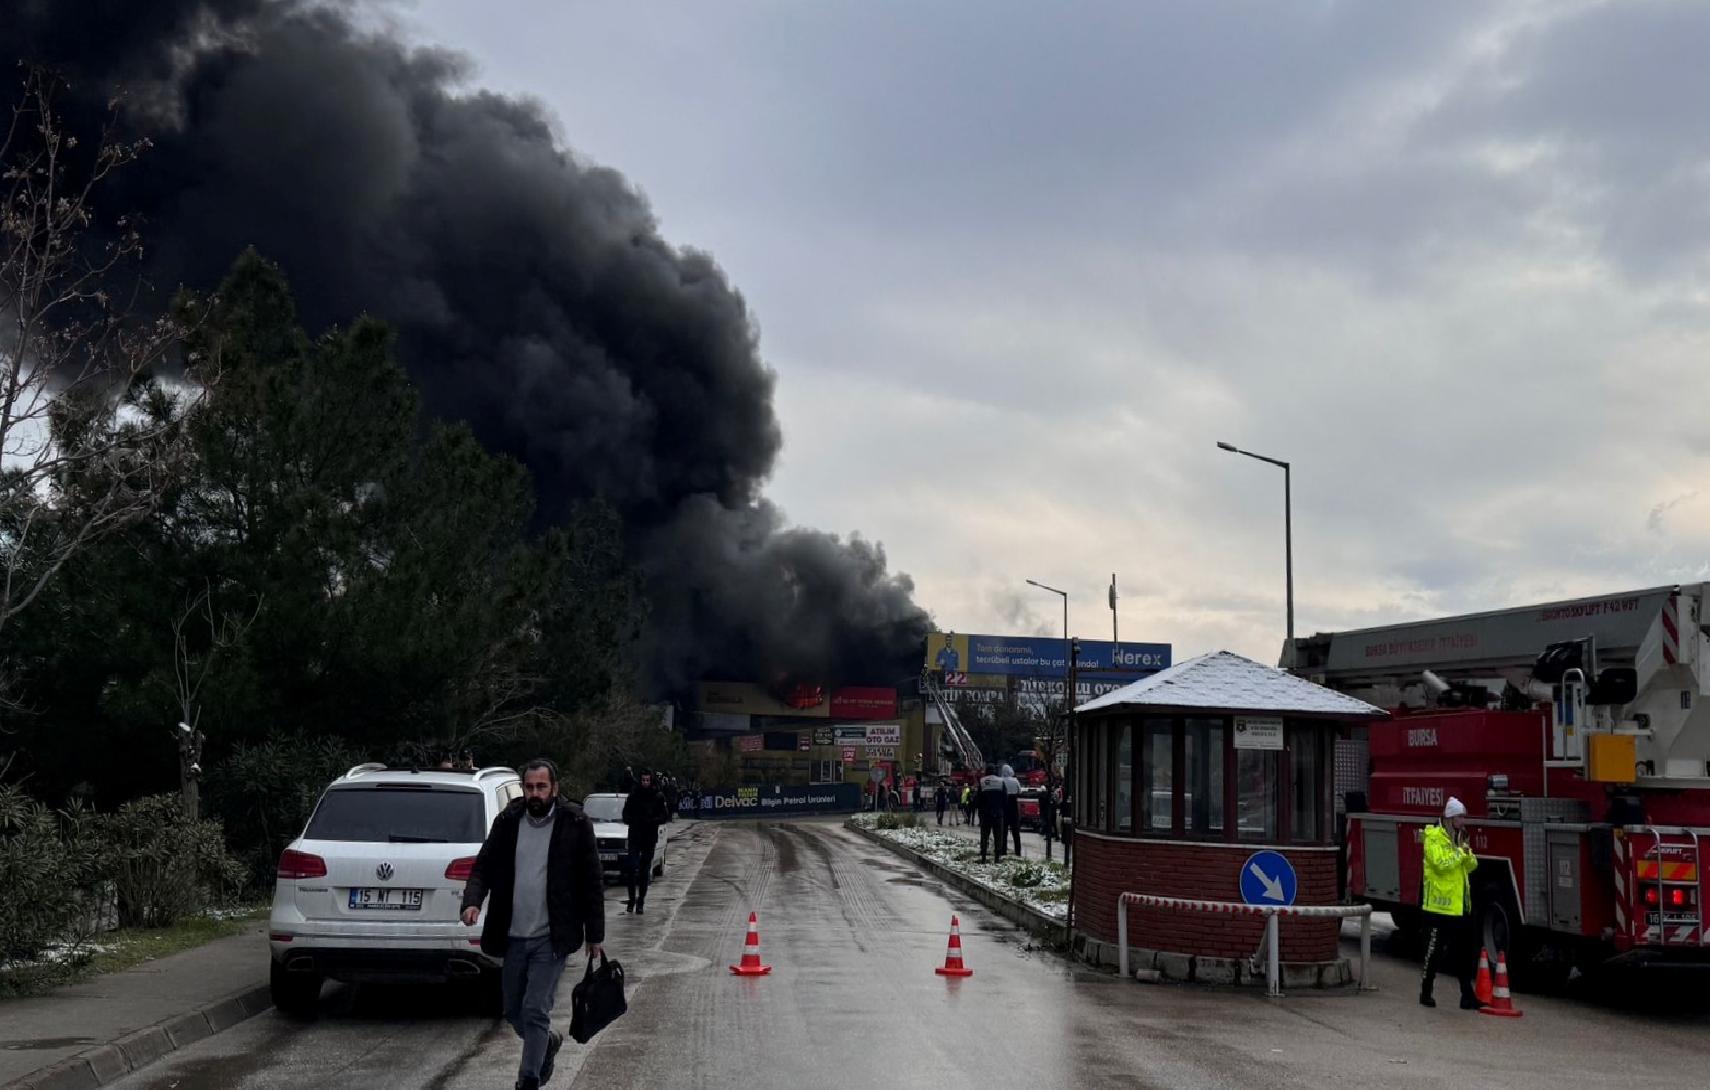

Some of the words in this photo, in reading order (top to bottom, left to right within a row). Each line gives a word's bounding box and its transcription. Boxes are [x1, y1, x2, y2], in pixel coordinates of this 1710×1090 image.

[1040, 657, 1051, 666] bu
[946, 672, 967, 685] 22
[1408, 728, 1438, 747] BURSA
[715, 795, 758, 808] Delvac
[761, 797, 782, 807] Bilgin
[359, 890, 371, 902] 15
[402, 890, 420, 903] 115
